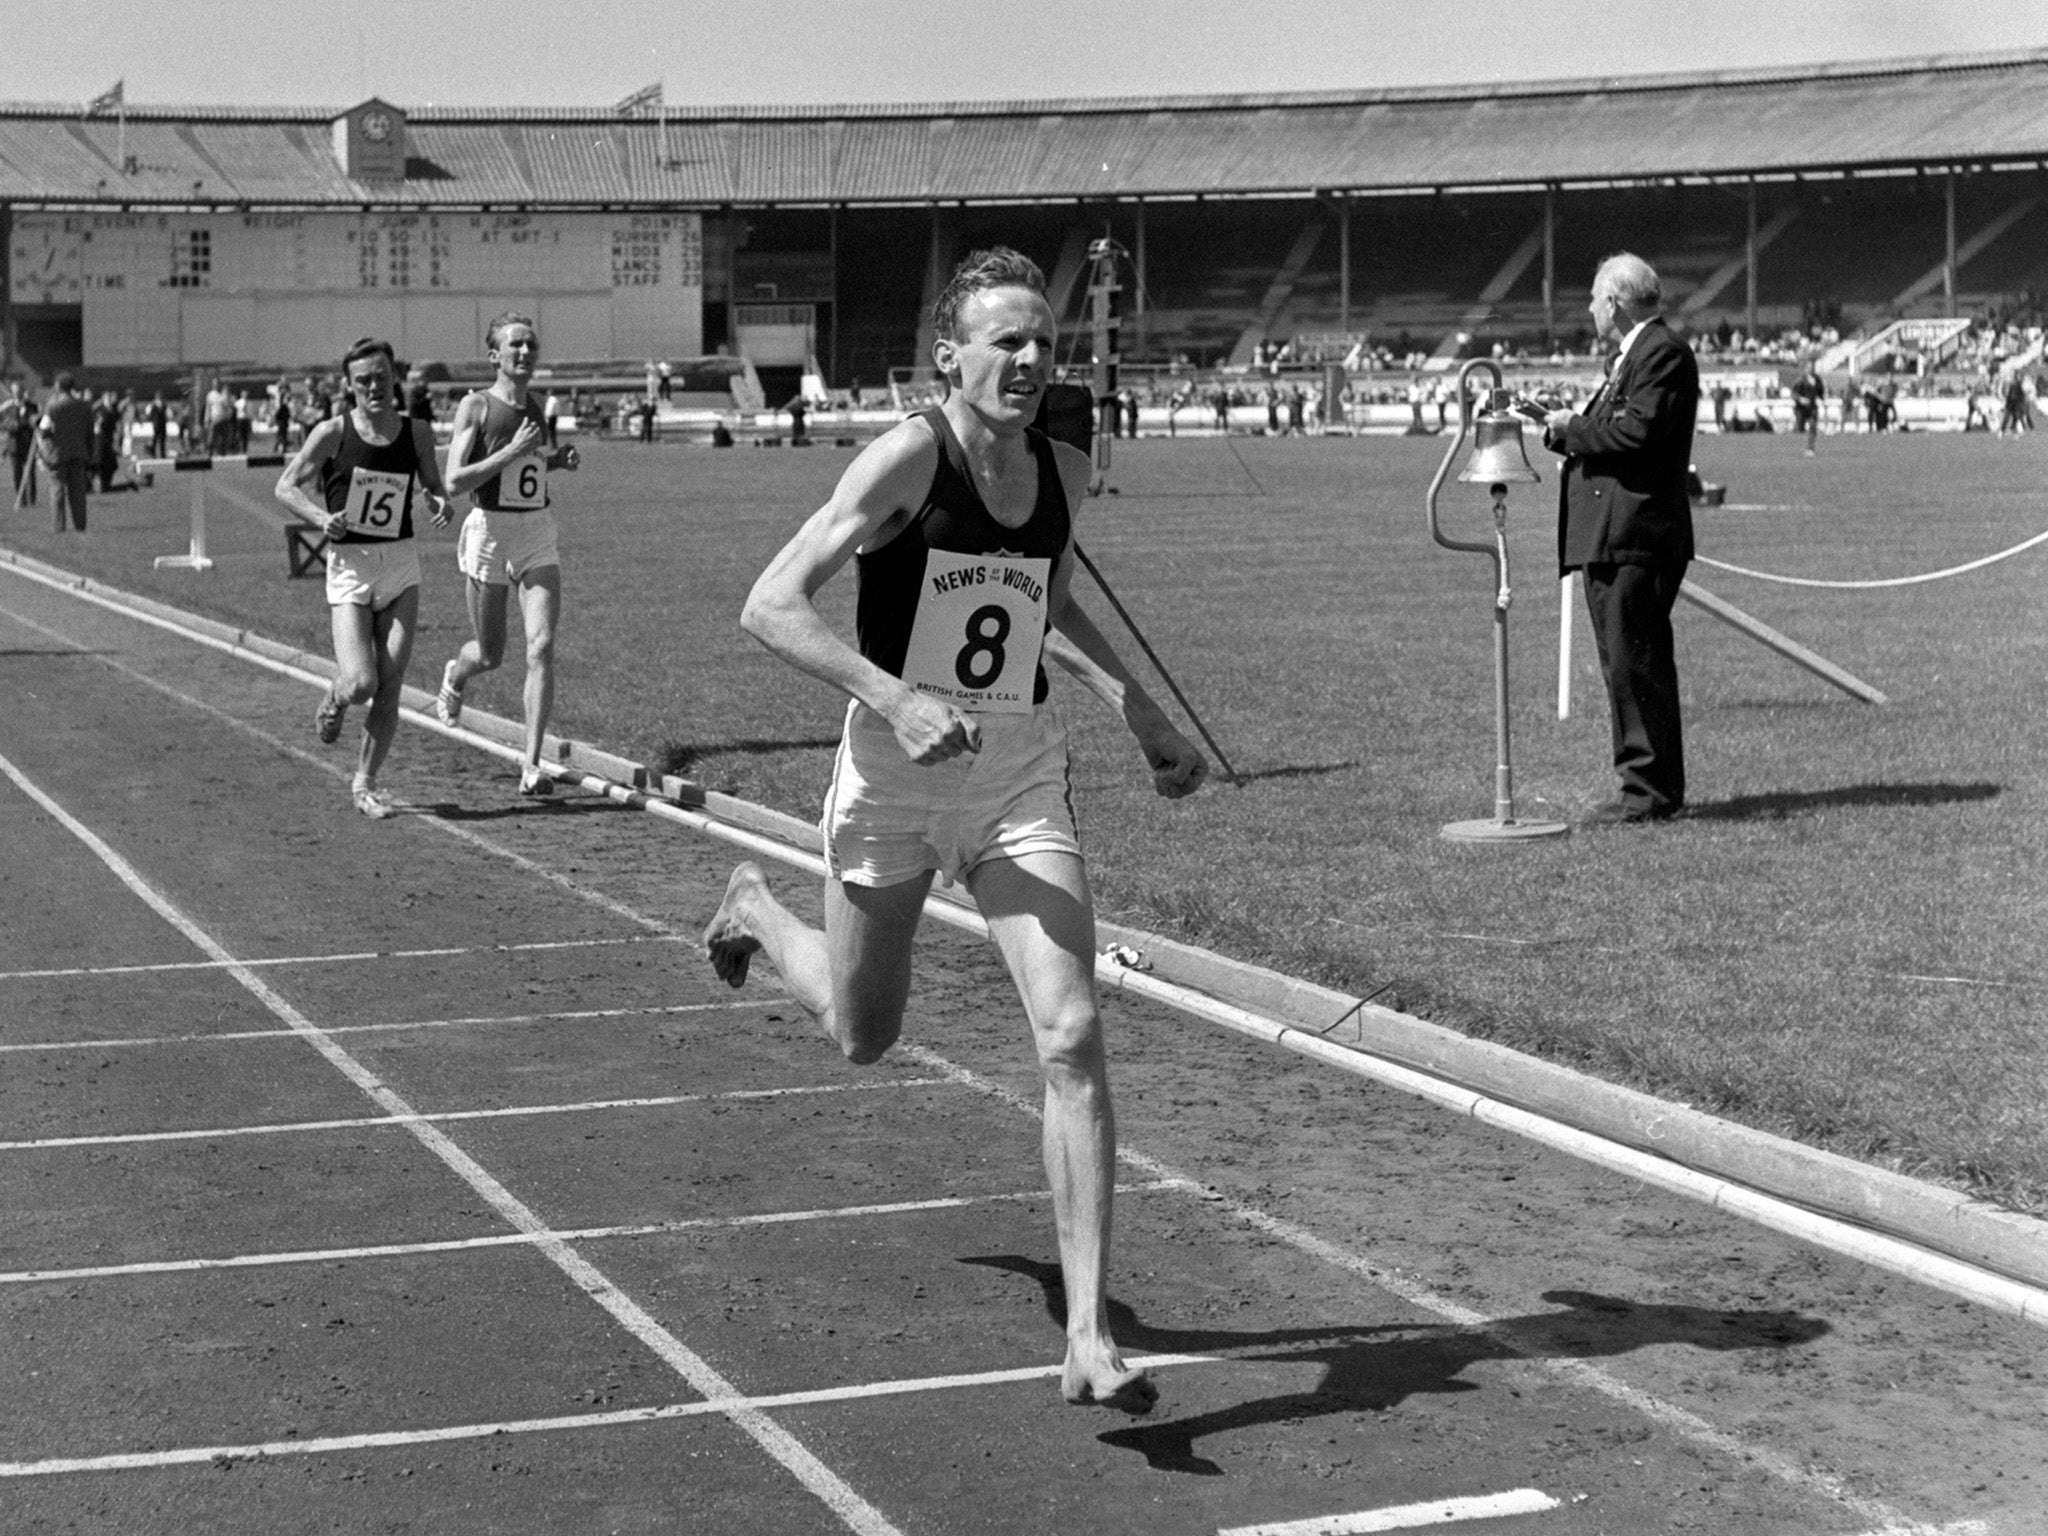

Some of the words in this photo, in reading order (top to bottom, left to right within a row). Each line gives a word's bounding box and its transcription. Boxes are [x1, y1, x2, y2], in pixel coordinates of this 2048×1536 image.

[631, 215, 691, 228] POINTS
[612, 230, 671, 242] SURREY
[612, 260, 661, 272] LANCS
[86, 275, 125, 288] TIME
[612, 274, 659, 287] STAFF
[519, 463, 538, 499] 6
[359, 489, 396, 527] 15
[932, 566, 986, 594] NEWS
[1002, 567, 1044, 603] WORLD
[955, 604, 1011, 690] 8
[916, 682, 953, 697] BRITISH
[956, 690, 983, 700] GAMES
